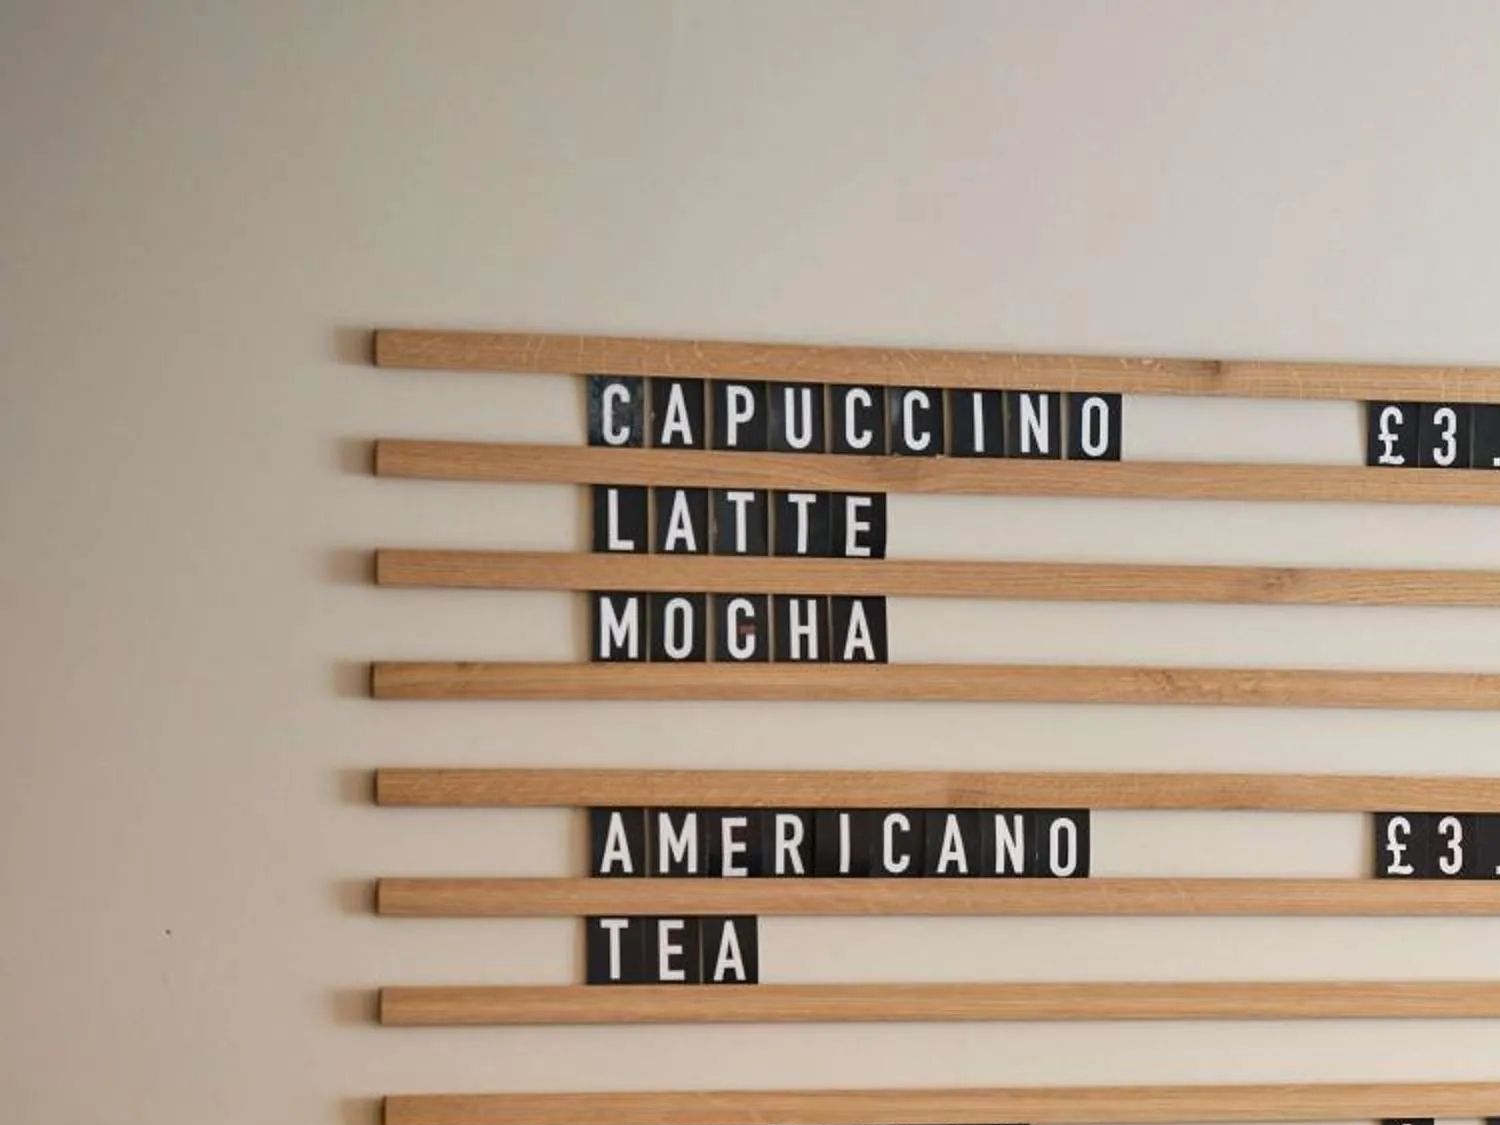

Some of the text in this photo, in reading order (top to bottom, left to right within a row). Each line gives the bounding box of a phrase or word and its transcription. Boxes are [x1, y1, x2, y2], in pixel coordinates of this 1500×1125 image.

[602, 383, 1110, 457] CAPUCCINO
[608, 489, 872, 557] LATTE
[600, 597, 876, 661] MOCHA
[600, 812, 1077, 877] AMERICANO
[600, 919, 746, 981] TEA
